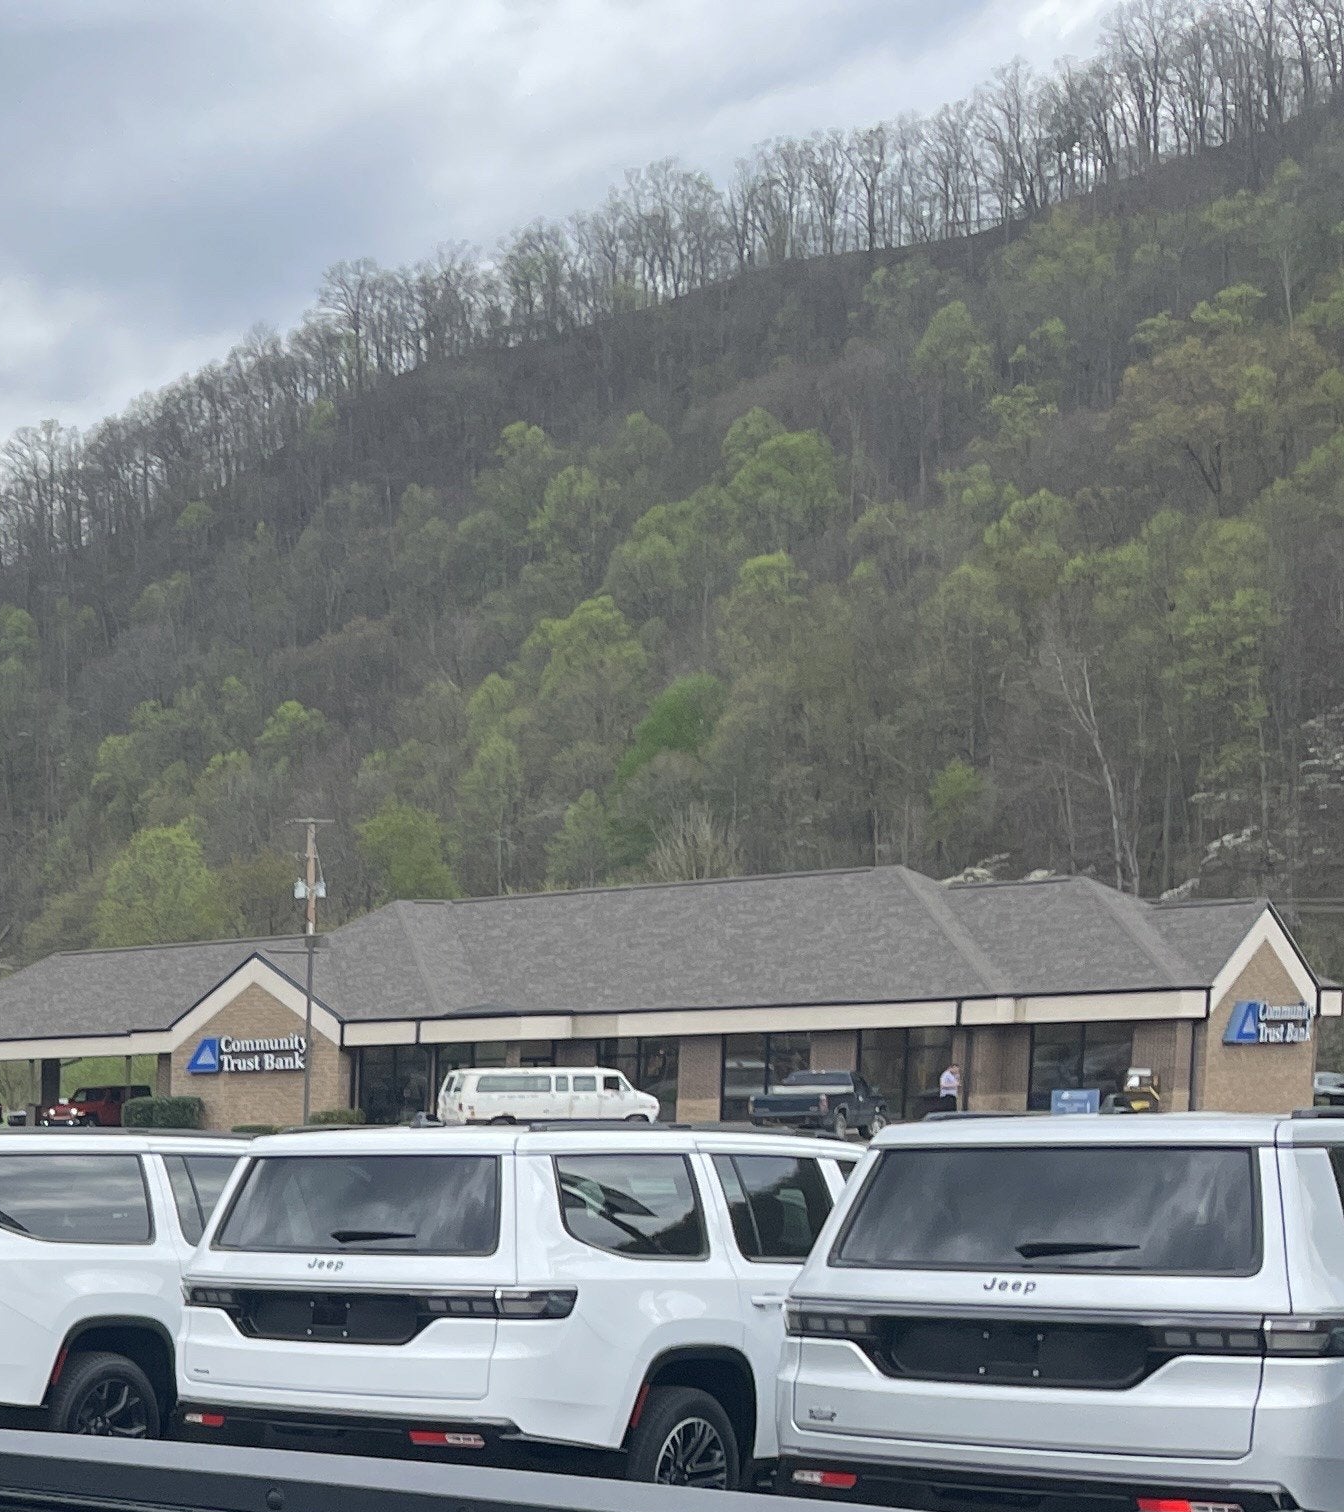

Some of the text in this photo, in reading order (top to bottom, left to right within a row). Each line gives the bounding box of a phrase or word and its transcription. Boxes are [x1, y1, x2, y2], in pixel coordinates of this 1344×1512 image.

[220, 1033, 306, 1054] Community
[220, 1052, 305, 1072] Trust Bank
[307, 1257, 344, 1271] Jeep
[983, 1277, 1037, 1295] Jeep
